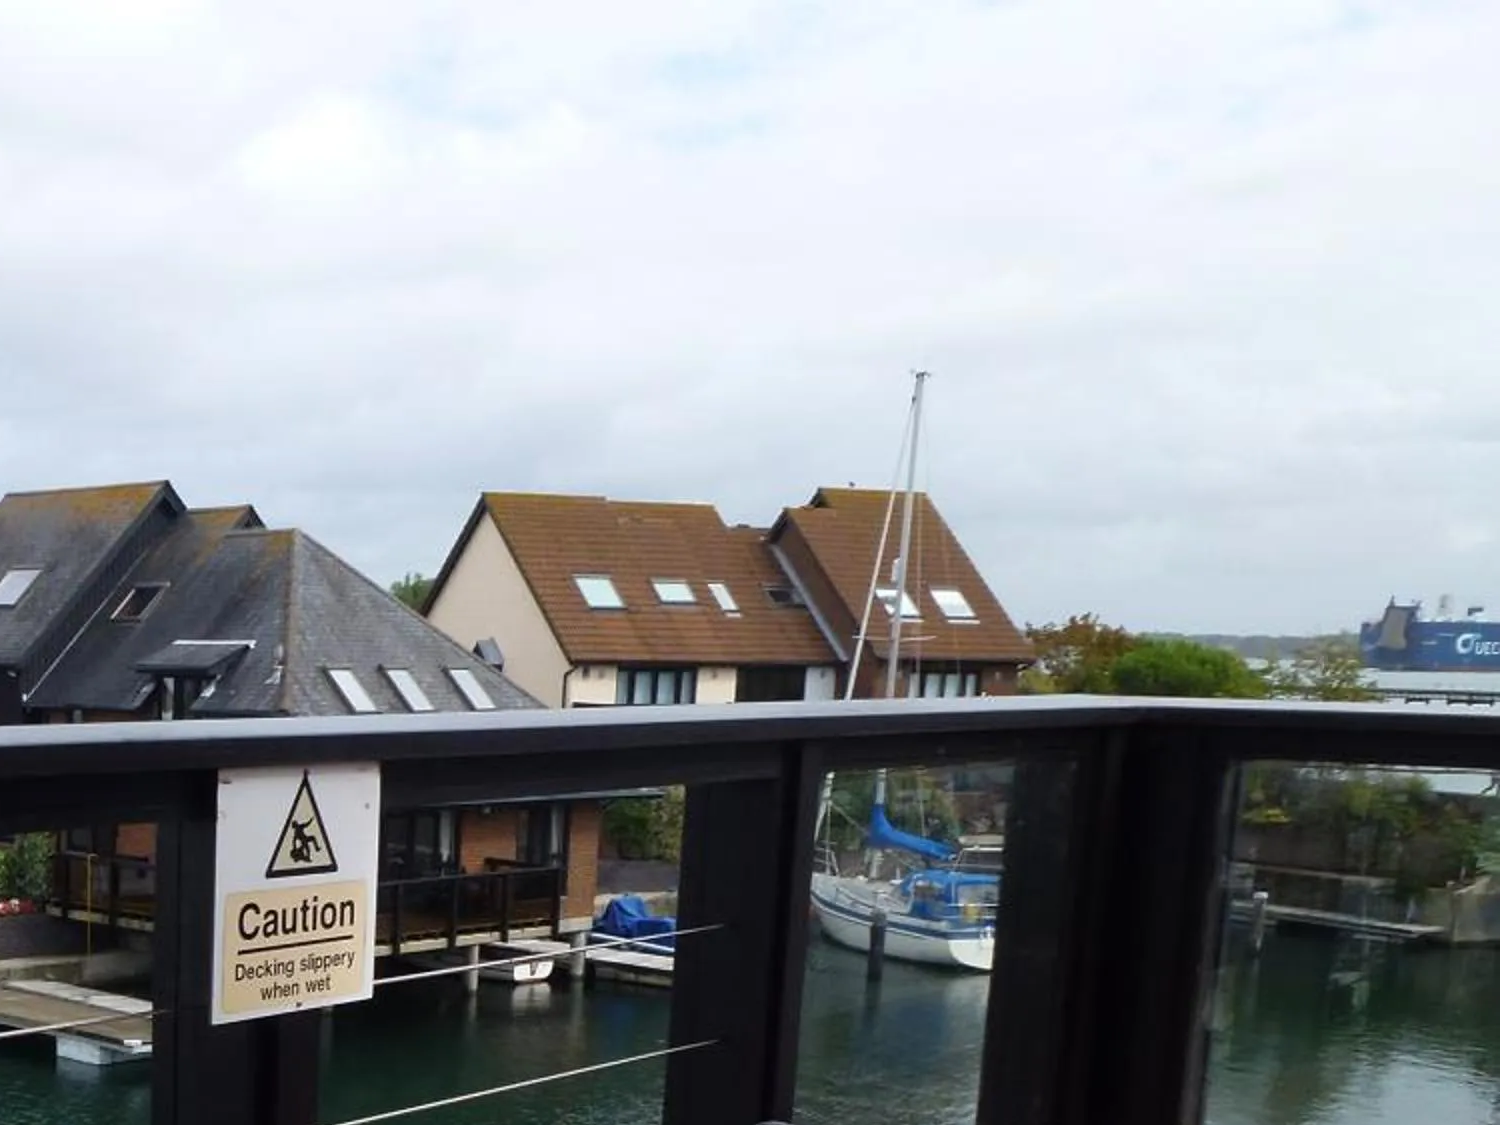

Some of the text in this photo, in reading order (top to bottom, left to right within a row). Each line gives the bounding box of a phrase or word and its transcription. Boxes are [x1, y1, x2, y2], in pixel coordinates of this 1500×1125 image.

[238, 896, 355, 940] Caution
[235, 952, 355, 979] Decking slippery
[260, 974, 331, 1000] when wet
